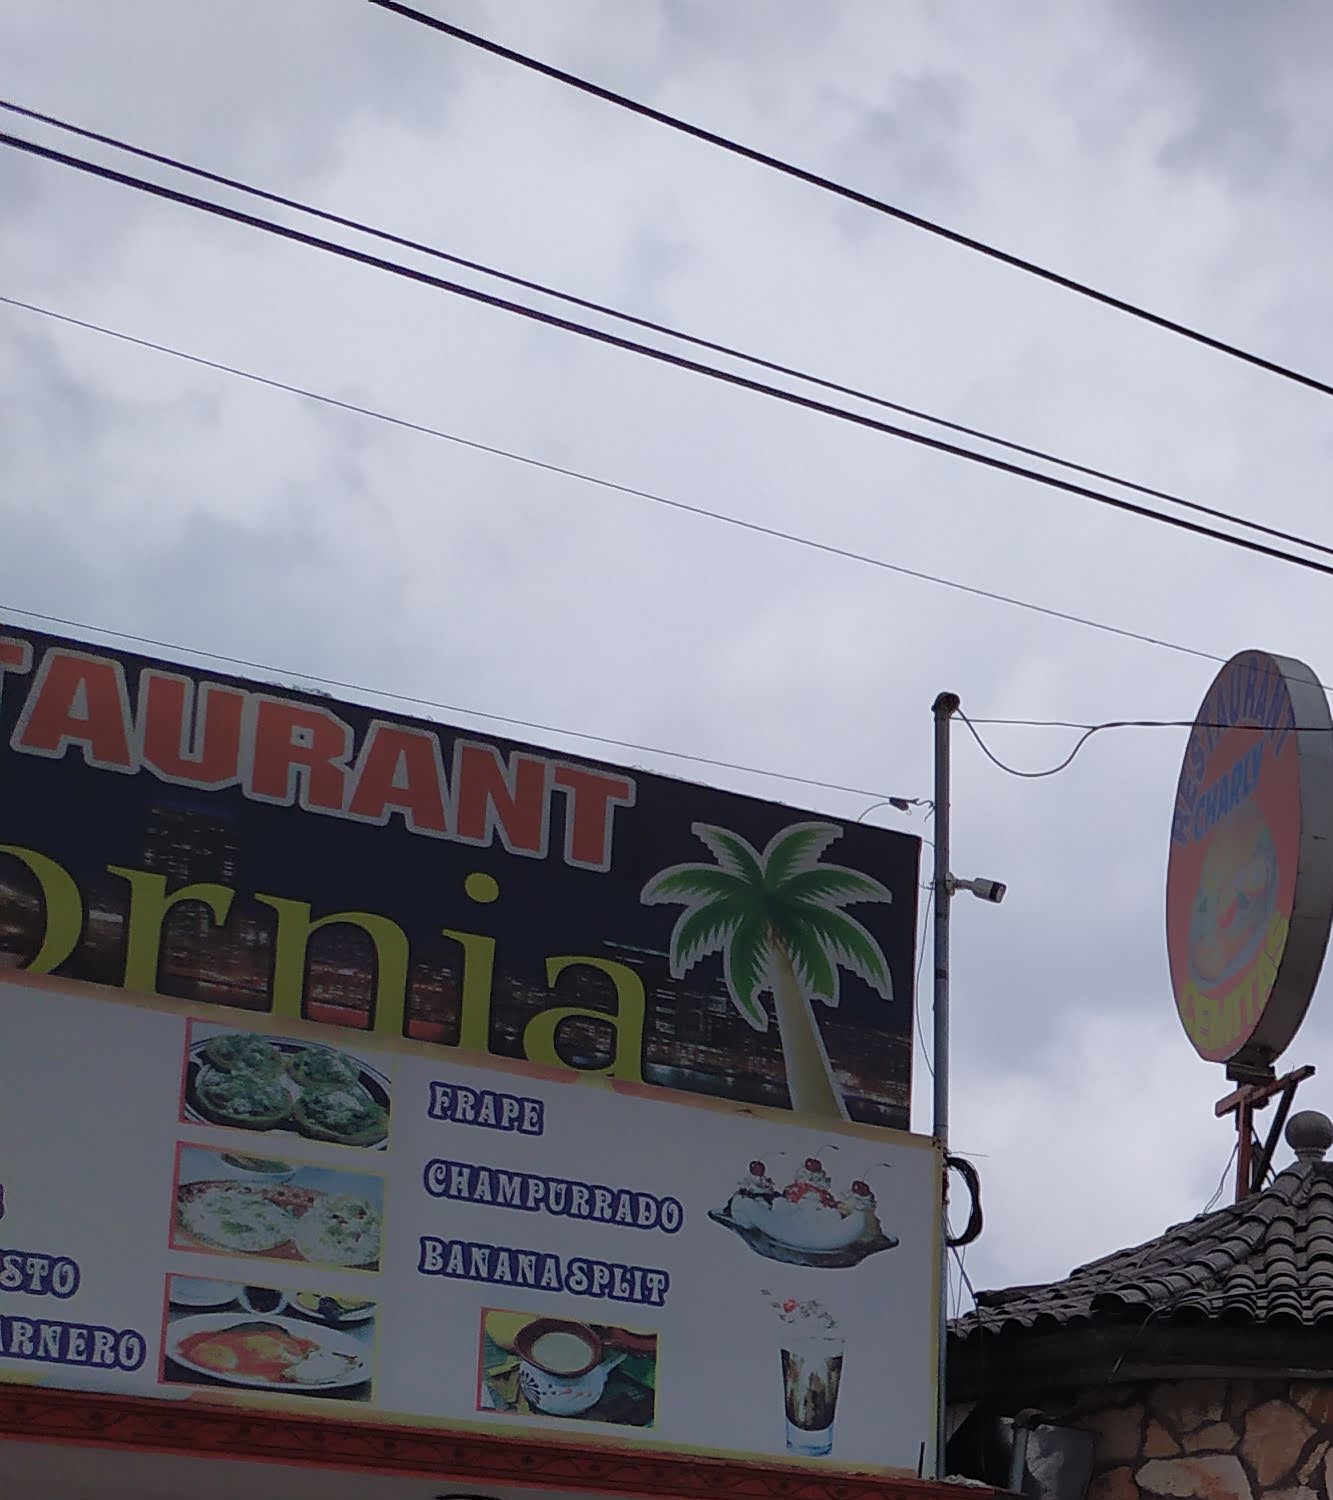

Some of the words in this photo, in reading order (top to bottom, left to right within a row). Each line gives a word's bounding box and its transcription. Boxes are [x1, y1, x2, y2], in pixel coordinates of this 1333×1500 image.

[428, 1082, 544, 1136] FRAPE
[424, 1159, 684, 1233] CHAMPURRADO
[418, 1236, 564, 1292] BANANA
[565, 1257, 670, 1306] SPLIT
[0, 1315, 146, 1371] RNERO
